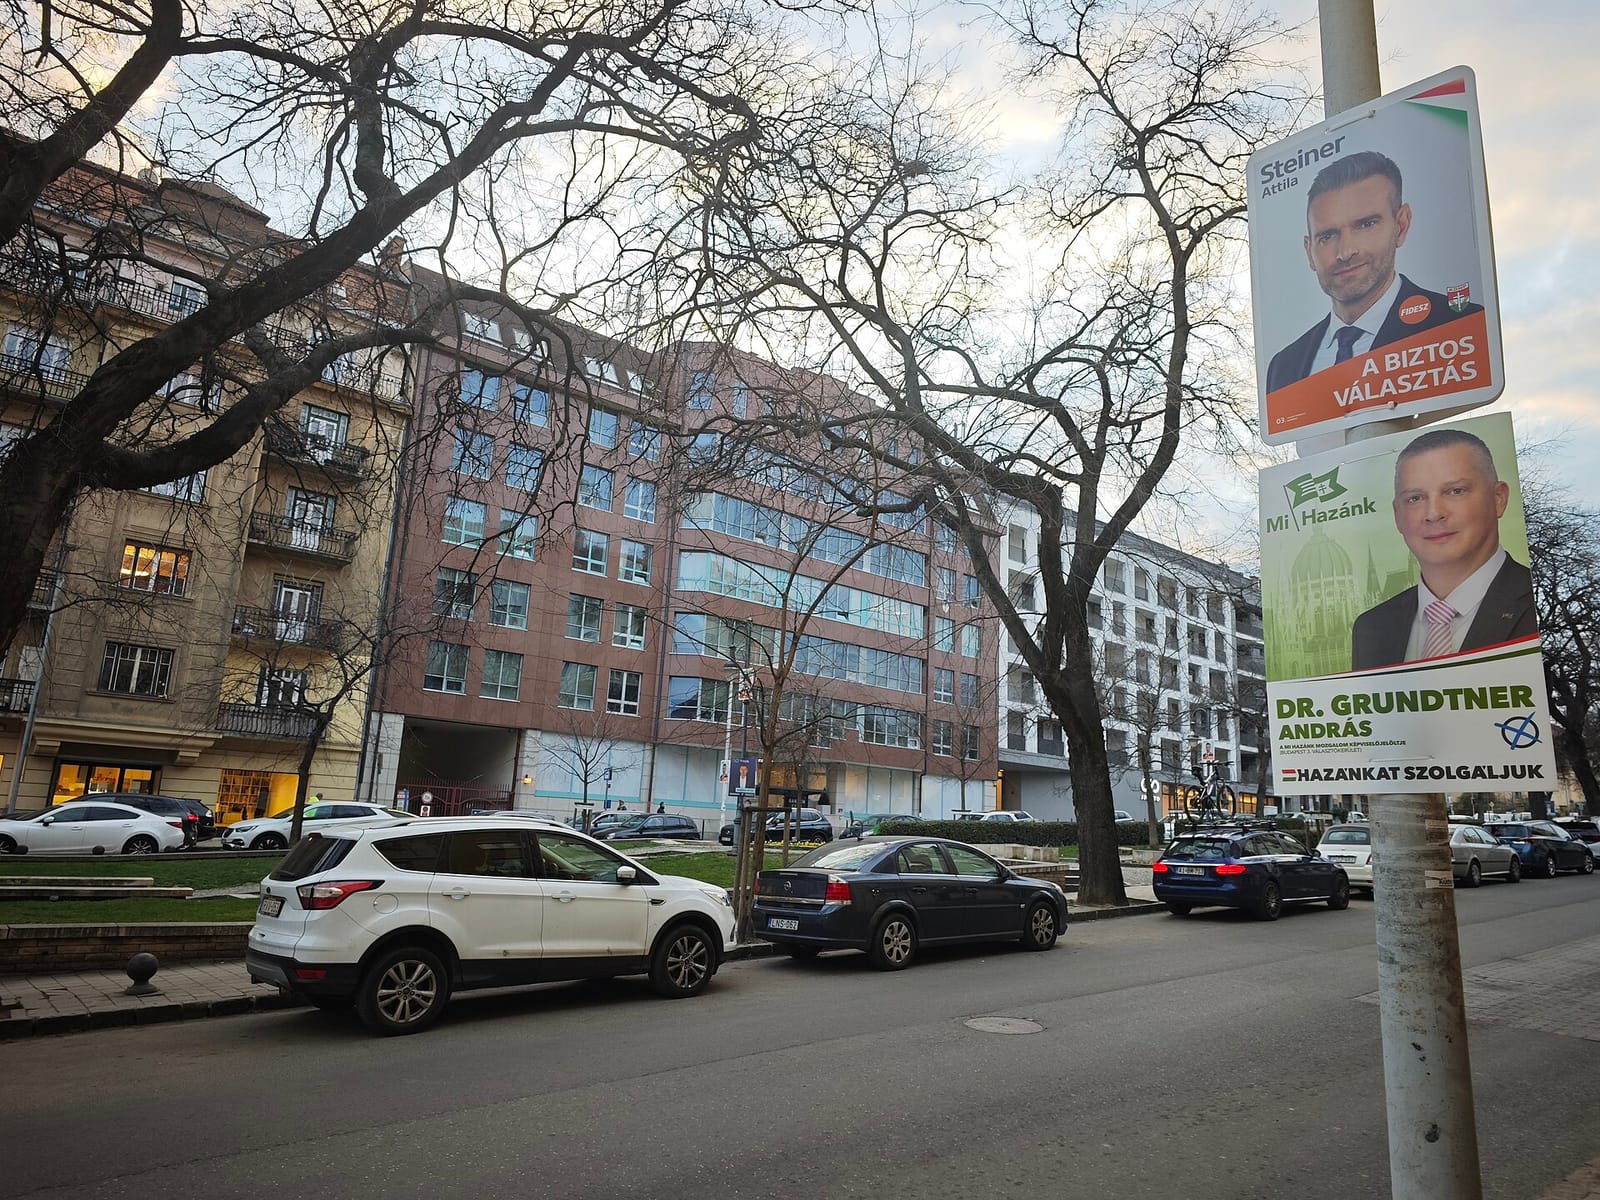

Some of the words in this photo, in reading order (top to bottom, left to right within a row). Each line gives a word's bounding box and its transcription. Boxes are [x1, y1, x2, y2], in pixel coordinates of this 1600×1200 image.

[1260, 135, 1346, 185] Steiner
[1261, 177, 1299, 200] Attila
[1400, 302, 1430, 317] FIDESZ
[1361, 358, 1379, 378] A
[1384, 335, 1475, 372] BIZTOS
[1333, 360, 1478, 407] VÁLASZTÁS
[1266, 514, 1289, 534] Mi
[1301, 496, 1377, 527] Hazánk
[1276, 697, 1325, 720] DR.
[1331, 685, 1536, 716] GRUNDTNER
[1278, 717, 1373, 741] ANDRÁS
[1315, 741, 1349, 749] MOZGALOM
[1297, 765, 1401, 783] HAZÁNKAT
[1404, 764, 1545, 781] SZOLGÁLJUK
